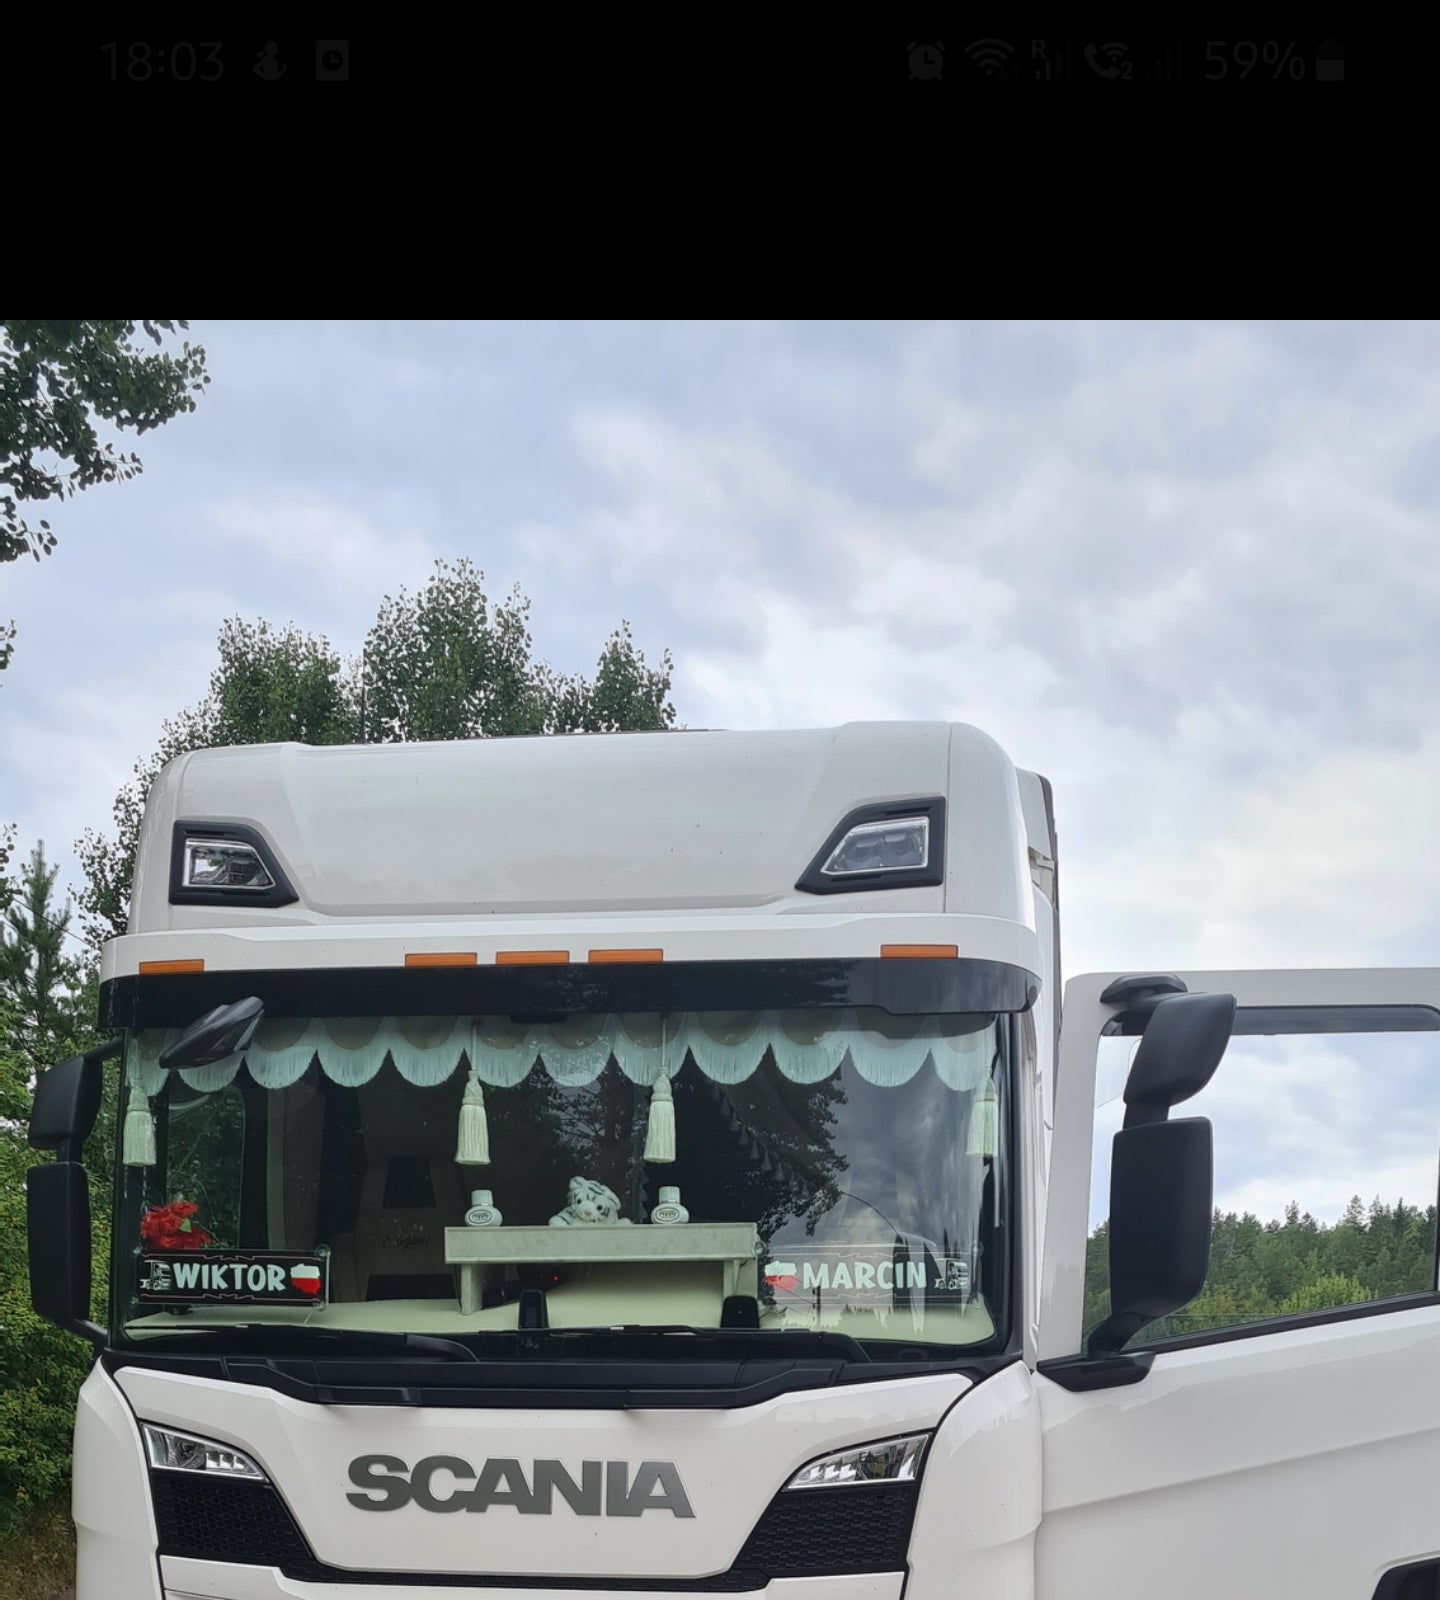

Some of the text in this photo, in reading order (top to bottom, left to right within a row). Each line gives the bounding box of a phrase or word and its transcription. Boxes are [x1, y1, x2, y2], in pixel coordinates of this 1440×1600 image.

[173, 1262, 286, 1292] WIKTOR
[803, 1261, 927, 1290] MARCIN
[345, 1453, 697, 1518] SCANIA
